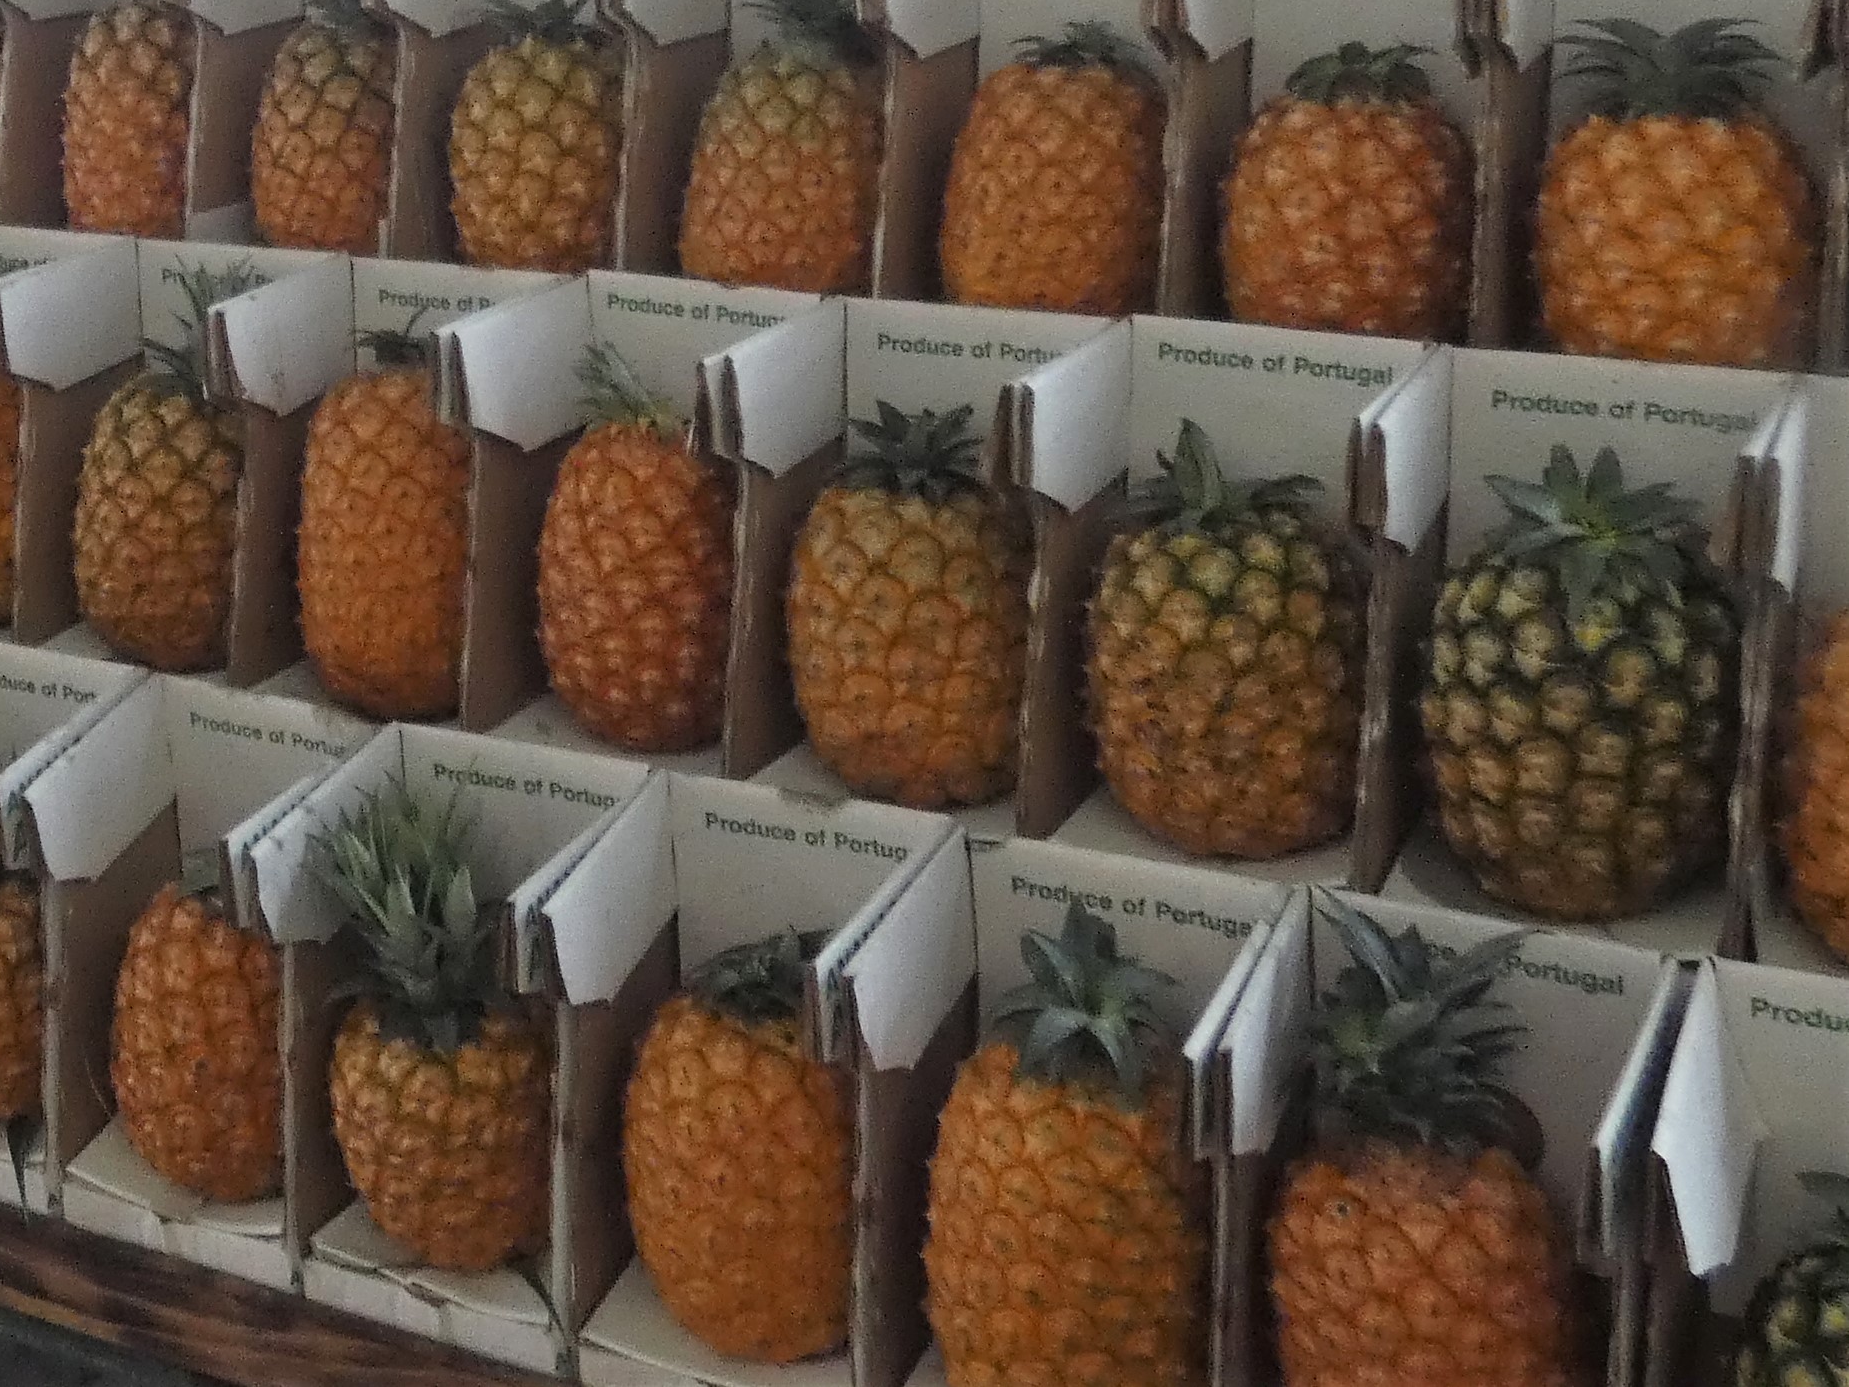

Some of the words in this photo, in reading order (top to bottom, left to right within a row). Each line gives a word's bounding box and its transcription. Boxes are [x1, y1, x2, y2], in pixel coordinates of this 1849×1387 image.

[378, 289, 451, 311] Produce
[607, 293, 684, 318] Produce
[691, 304, 710, 320] of
[877, 332, 964, 357] Produce
[971, 340, 992, 359] of
[1158, 341, 1253, 369] Produce
[1262, 354, 1286, 372] of
[1294, 356, 1394, 387] Portugal
[1492, 389, 1600, 417] Produce
[1609, 400, 1636, 420] of
[1644, 401, 1759, 435] Portugal
[41, 682, 58, 699] of
[189, 711, 263, 741] Produce
[269, 727, 285, 746] of
[433, 762, 517, 792] Produce
[523, 779, 543, 796] of
[705, 812, 796, 842] Produce
[804, 830, 826, 847] of
[1122, 897, 1146, 916] of
